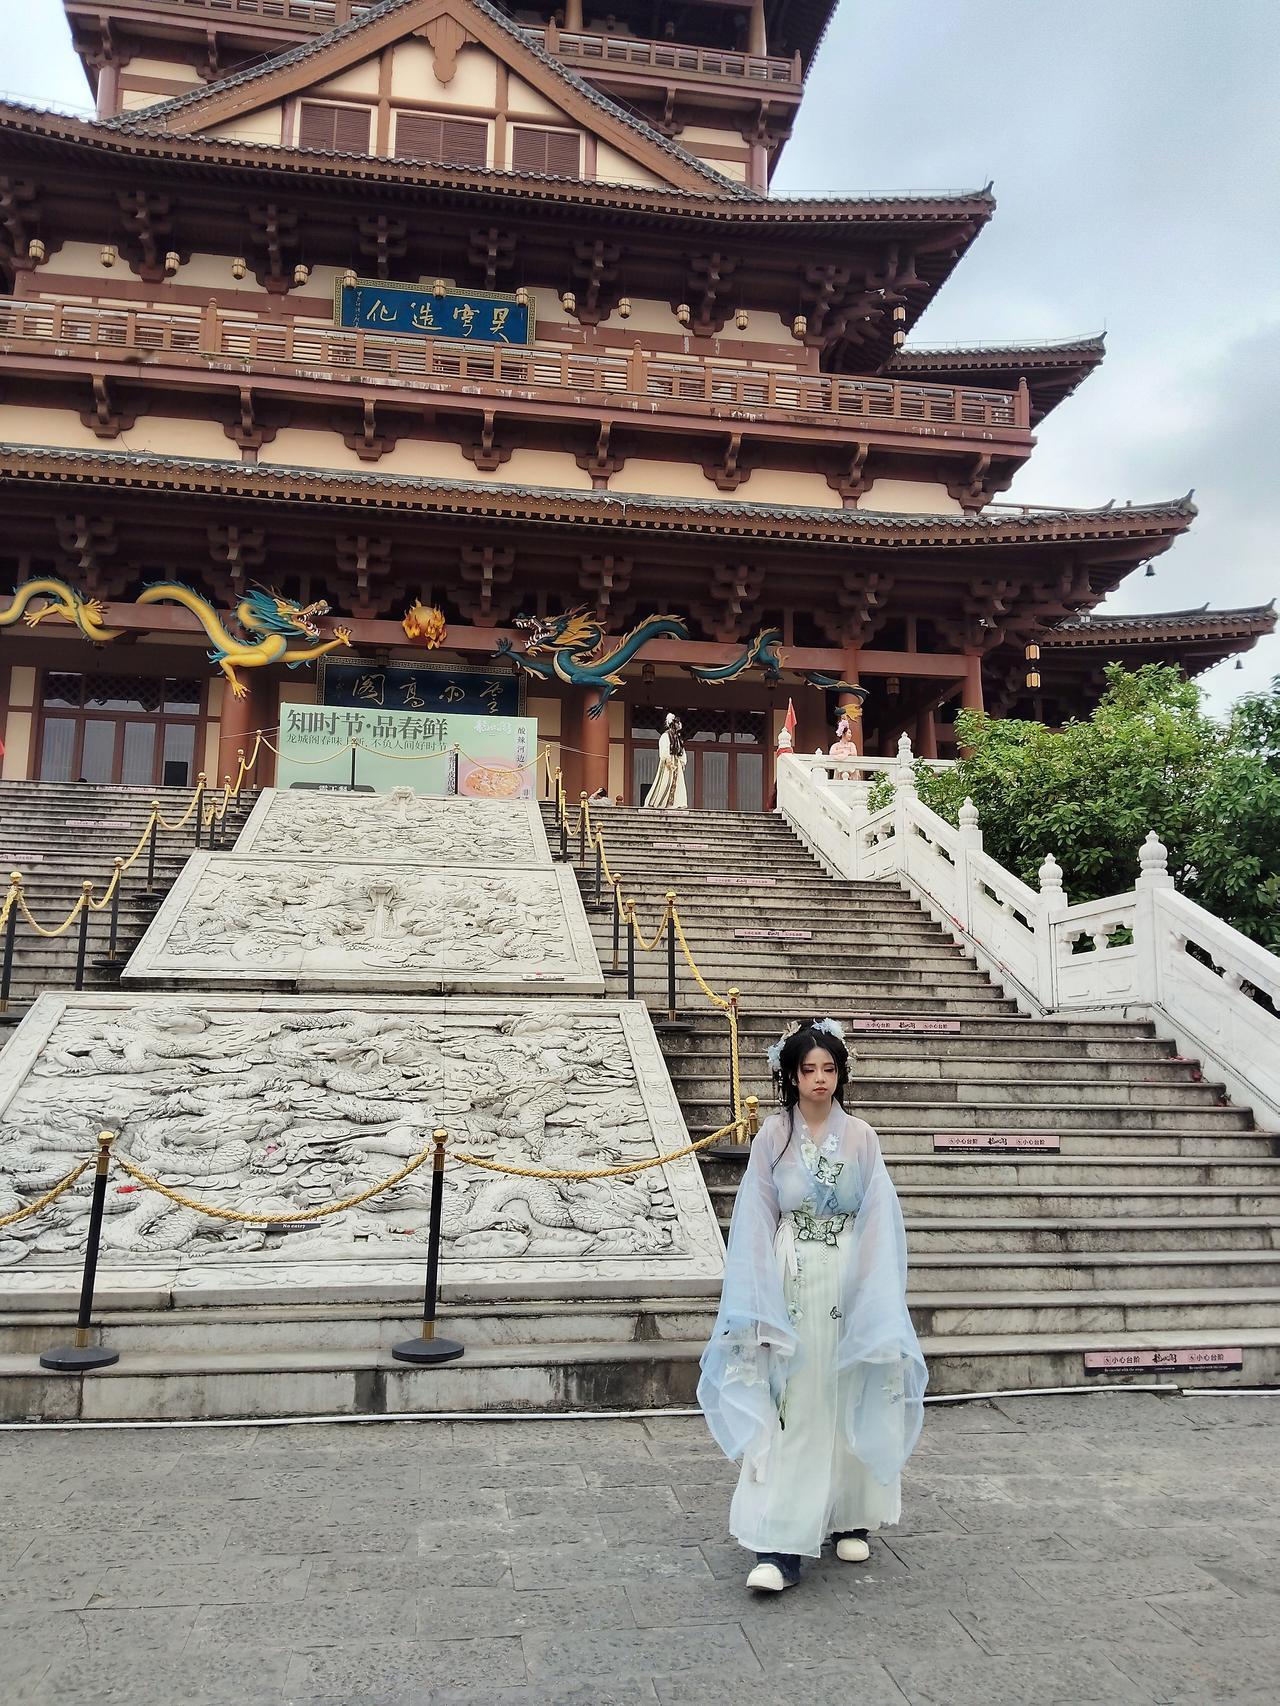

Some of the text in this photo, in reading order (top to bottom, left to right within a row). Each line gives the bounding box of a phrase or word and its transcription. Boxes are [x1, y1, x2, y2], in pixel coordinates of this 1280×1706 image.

[1111, 1353, 1224, 1364] 小心台阶 小心台阶
